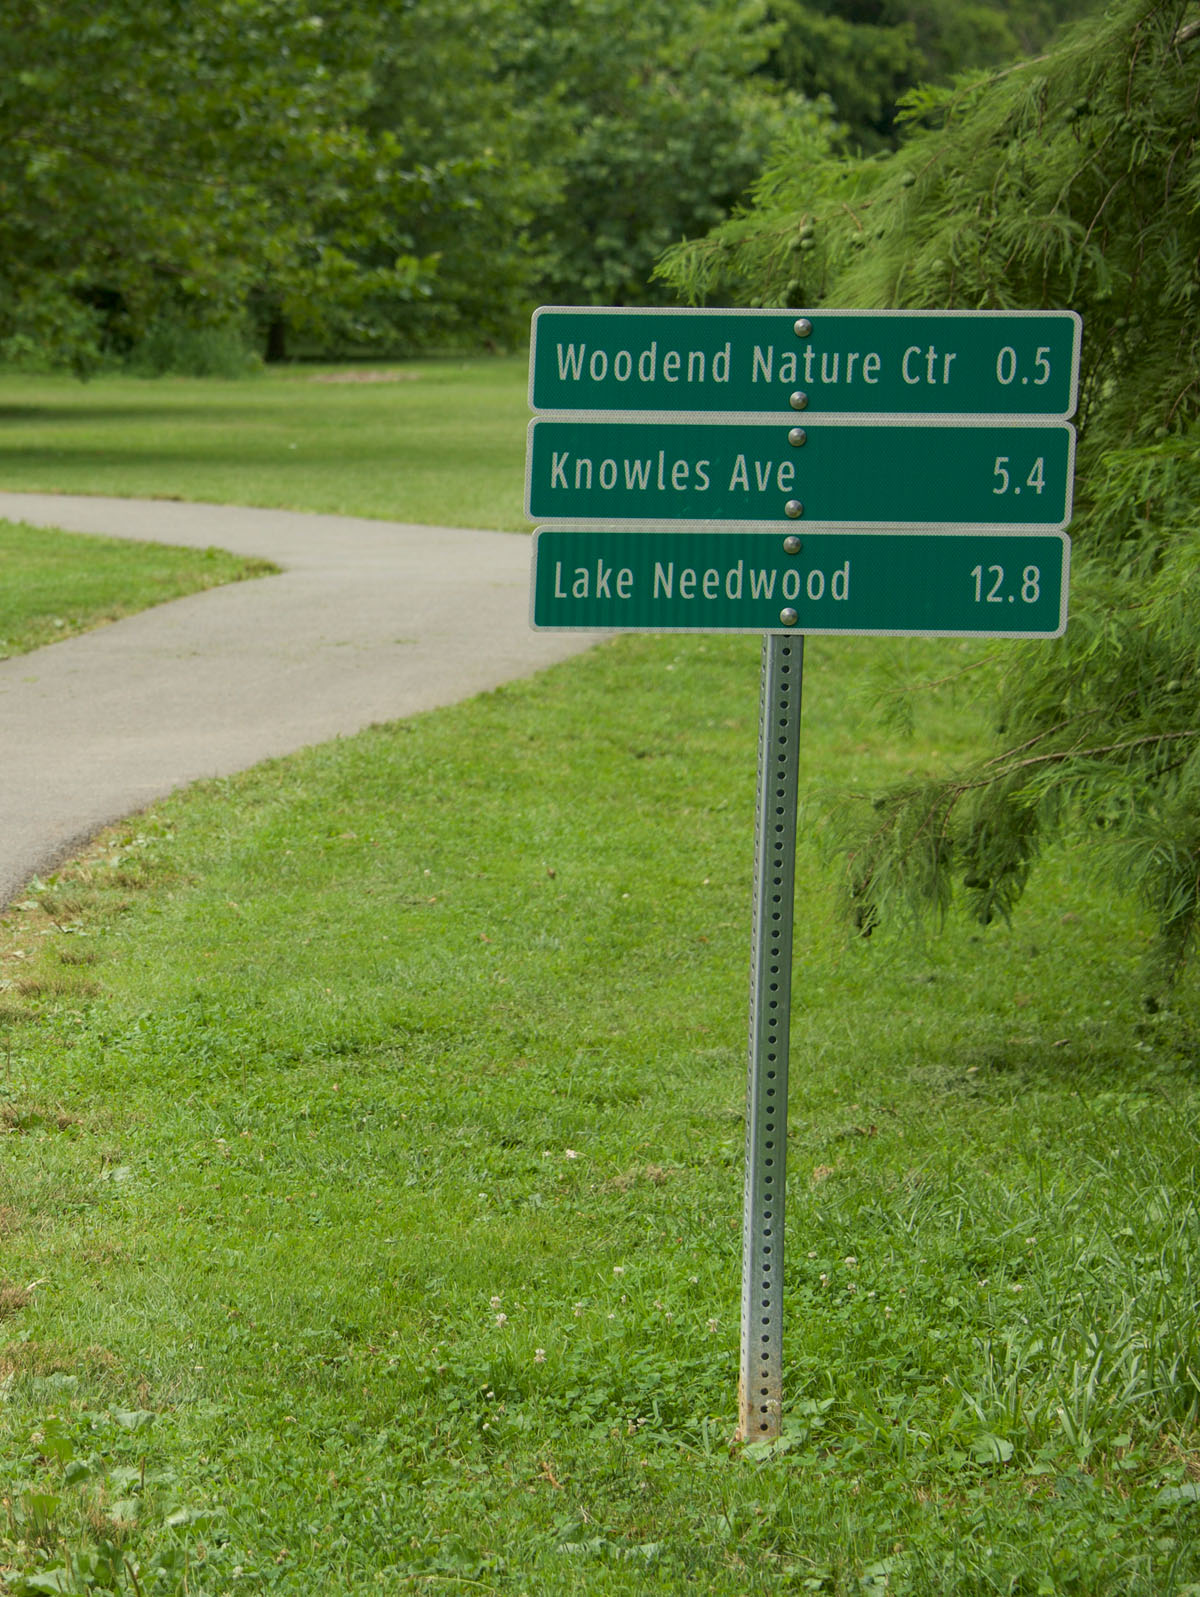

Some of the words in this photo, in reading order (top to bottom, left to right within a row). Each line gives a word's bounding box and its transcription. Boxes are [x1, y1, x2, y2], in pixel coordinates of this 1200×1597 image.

[557, 341, 731, 383] Woodend
[752, 345, 881, 384] Nature
[902, 345, 957, 385] Ctr
[996, 346, 1050, 385] 0.5
[551, 451, 710, 491] Knowles
[729, 454, 795, 492] Ave
[992, 456, 1045, 495] 5.4
[554, 558, 634, 599] Lake
[653, 559, 850, 601] Needwood
[970, 565, 1040, 603] 12.8
